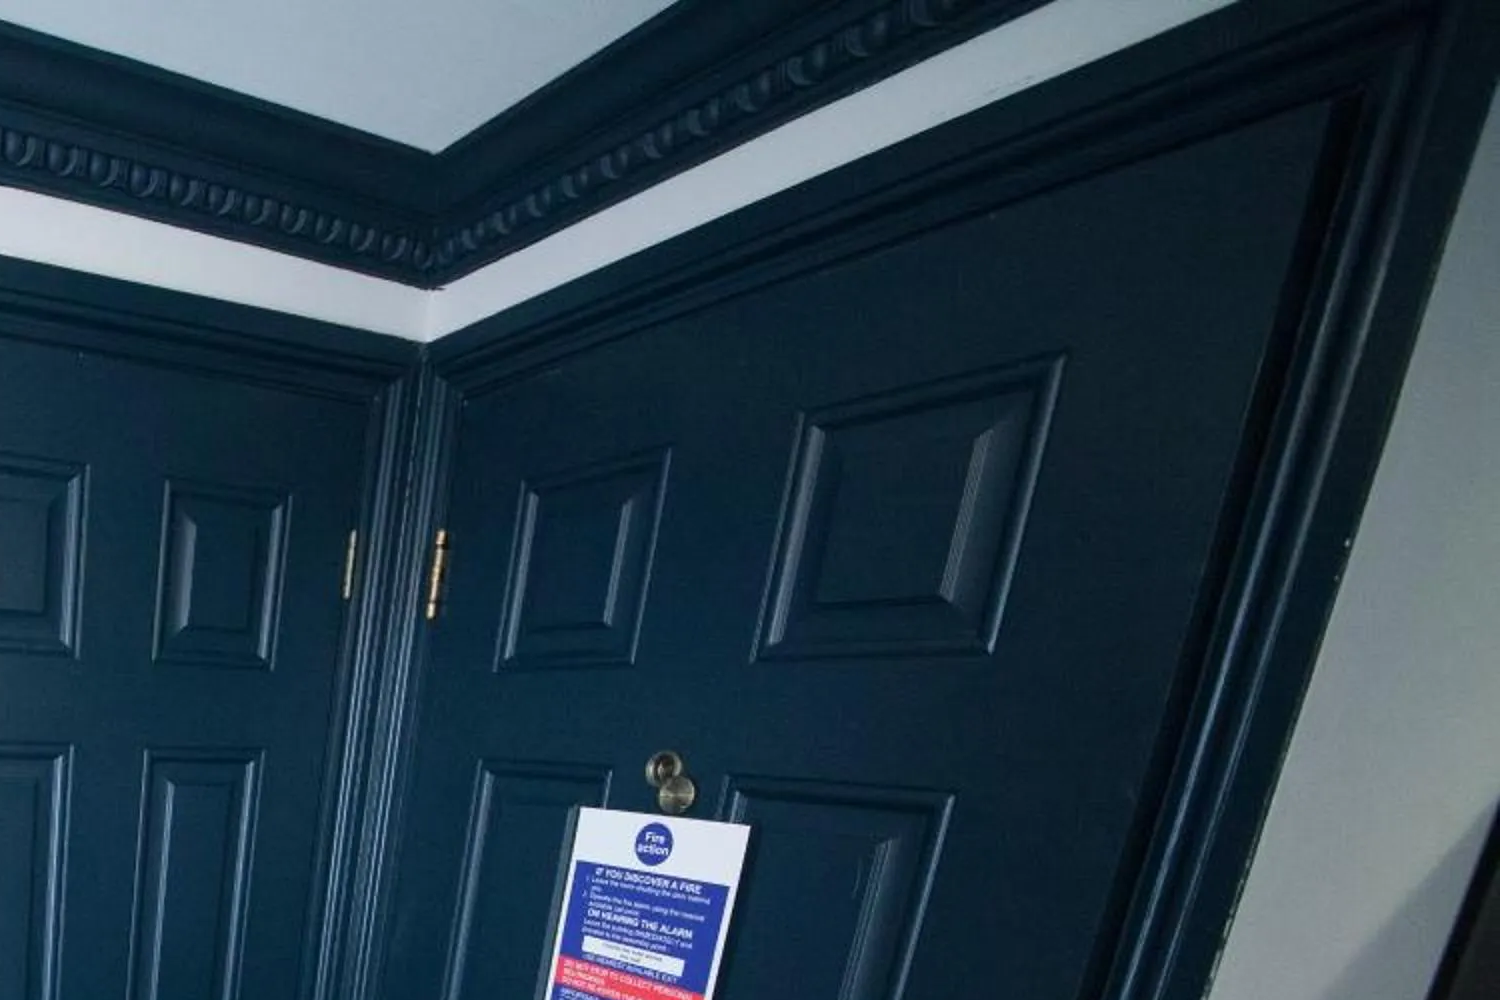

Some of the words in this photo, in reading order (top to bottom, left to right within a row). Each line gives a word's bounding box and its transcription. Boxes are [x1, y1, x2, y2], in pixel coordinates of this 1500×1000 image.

[645, 831, 665, 844] Fire
[637, 843, 669, 856] action
[606, 869, 622, 879] YOU
[624, 872, 668, 888] DISCOVER
[680, 882, 702, 894] FIRE
[587, 908, 600, 917] OR
[641, 920, 658, 930] THE
[660, 924, 692, 939] ALARM
